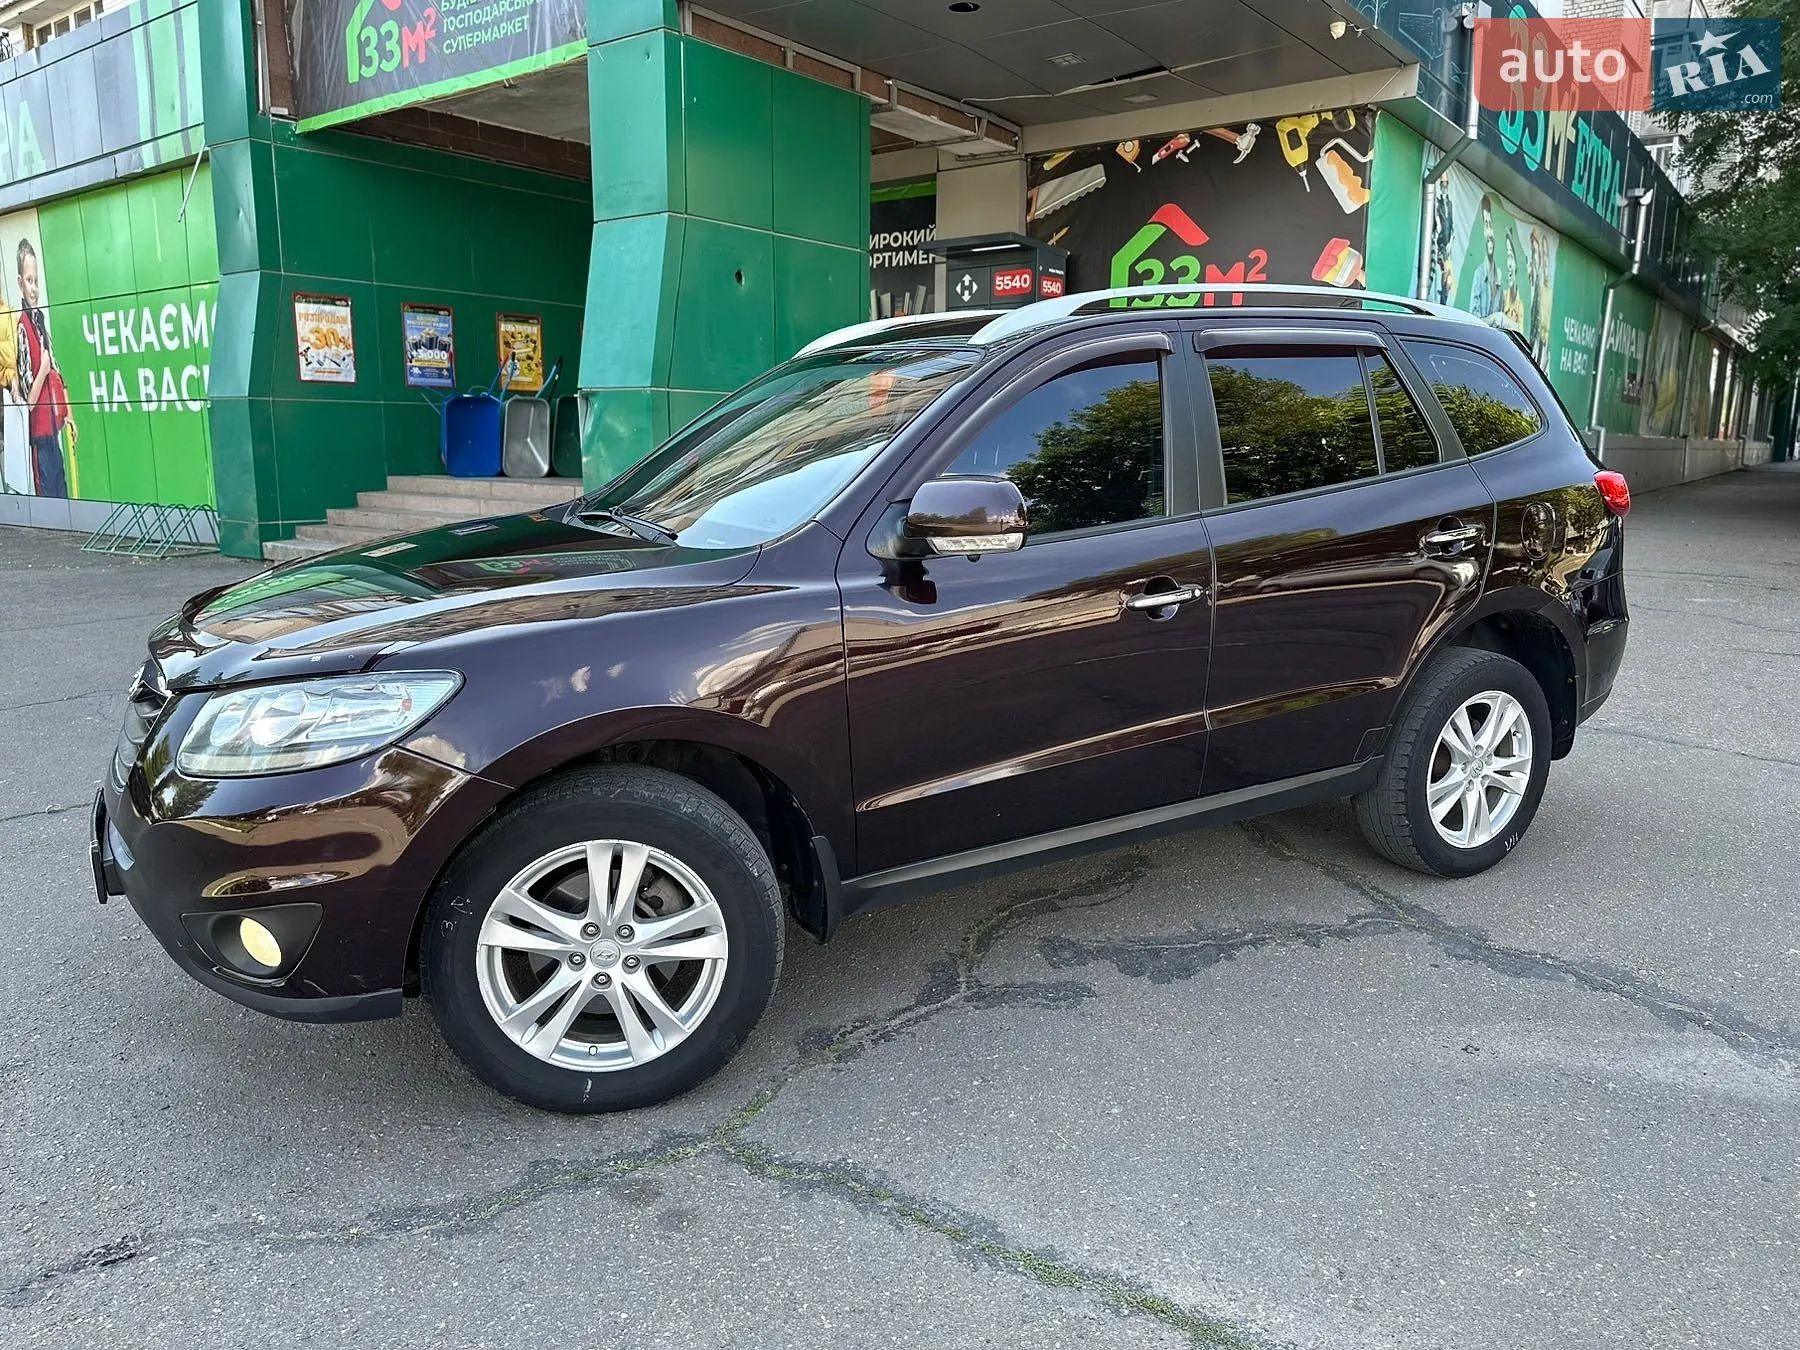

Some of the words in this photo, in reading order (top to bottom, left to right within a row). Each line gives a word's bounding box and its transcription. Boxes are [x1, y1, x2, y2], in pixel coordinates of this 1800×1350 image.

[443, 15, 529, 54] СУПЕРМАРКЕТ
[869, 249, 937, 268] РТИМЕ
[995, 274, 1030, 290] 5540
[1042, 280, 1061, 294] 5540
[82, 300, 218, 356] ЧЕКАЄМ
[89, 367, 131, 413] НА
[138, 363, 211, 412] ВАС!
